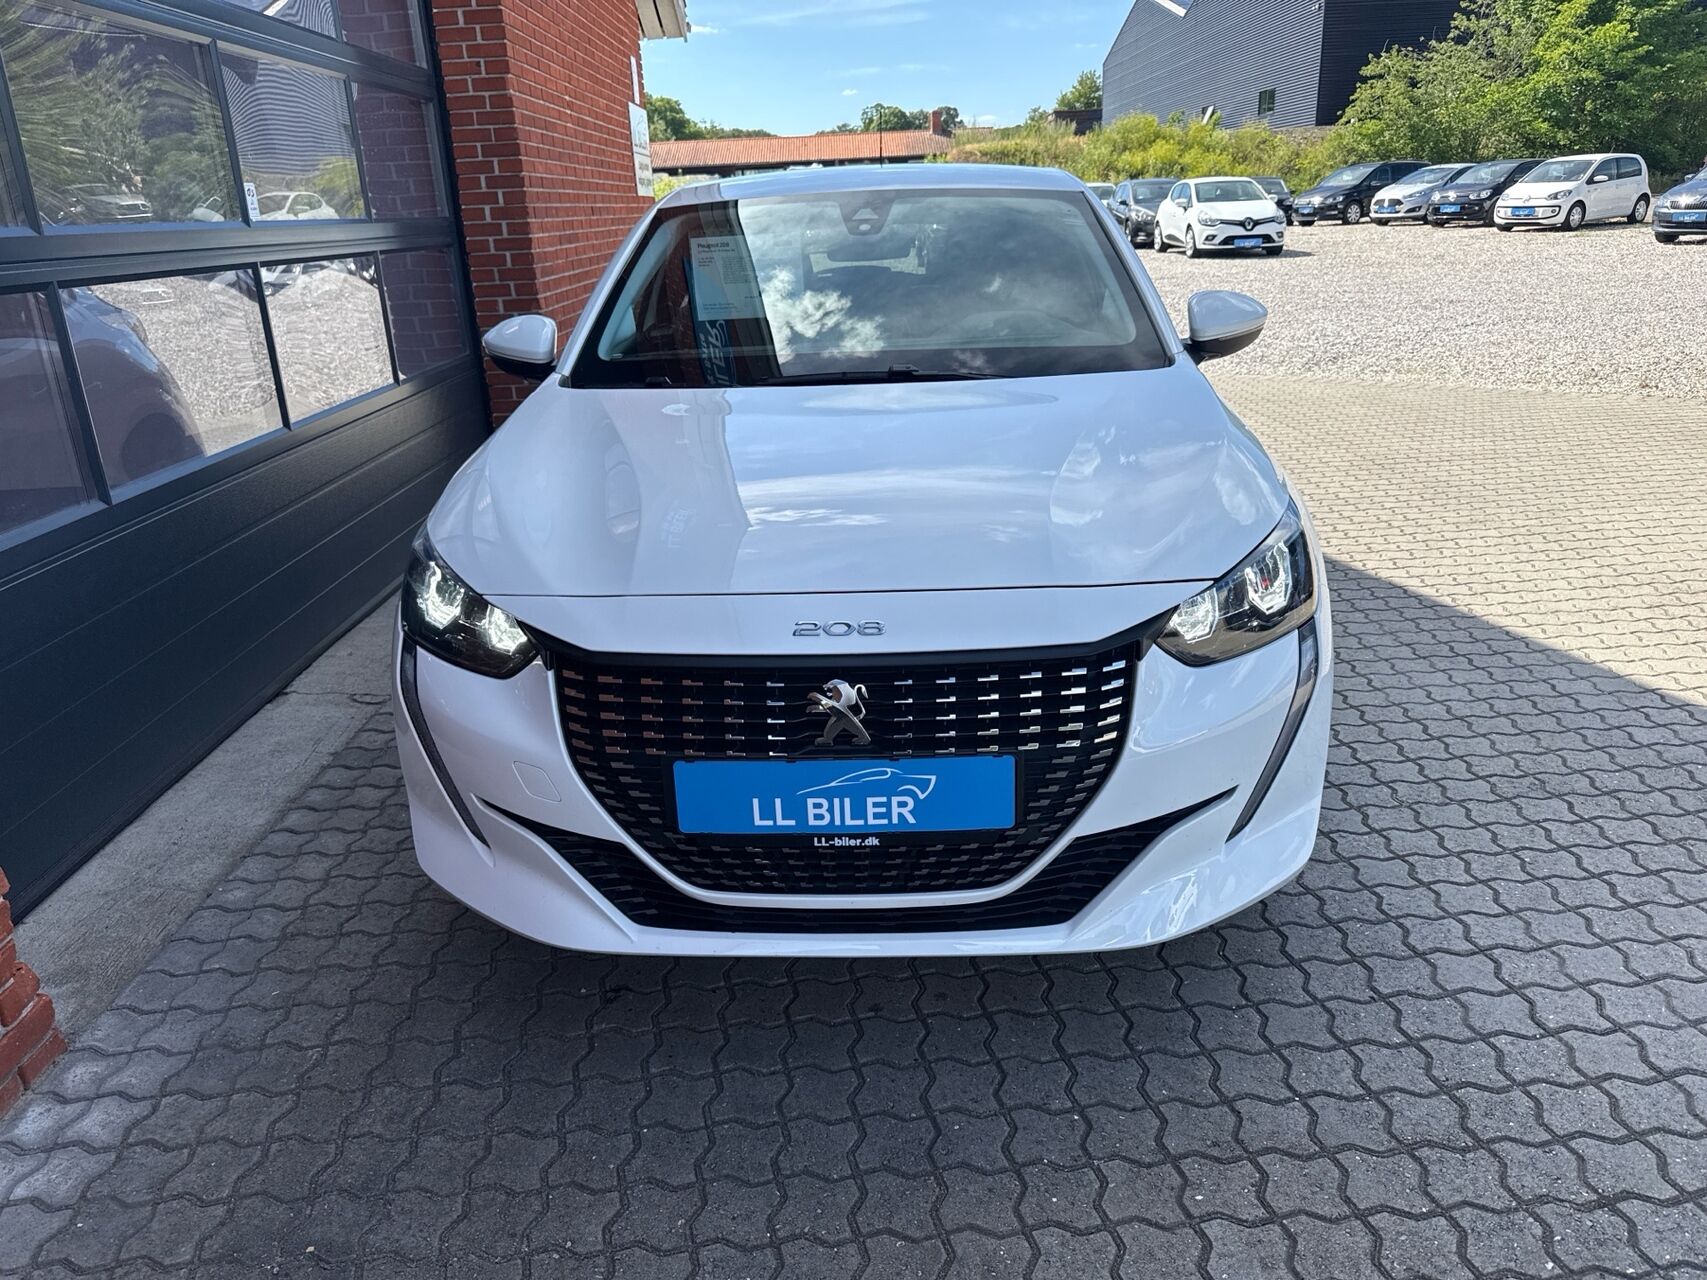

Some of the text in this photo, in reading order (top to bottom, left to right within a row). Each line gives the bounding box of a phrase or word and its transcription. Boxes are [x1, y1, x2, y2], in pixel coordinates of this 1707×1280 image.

[792, 620, 886, 637] 208
[752, 796, 917, 826] LL BILER
[813, 836, 881, 848] LL-biler.dk
